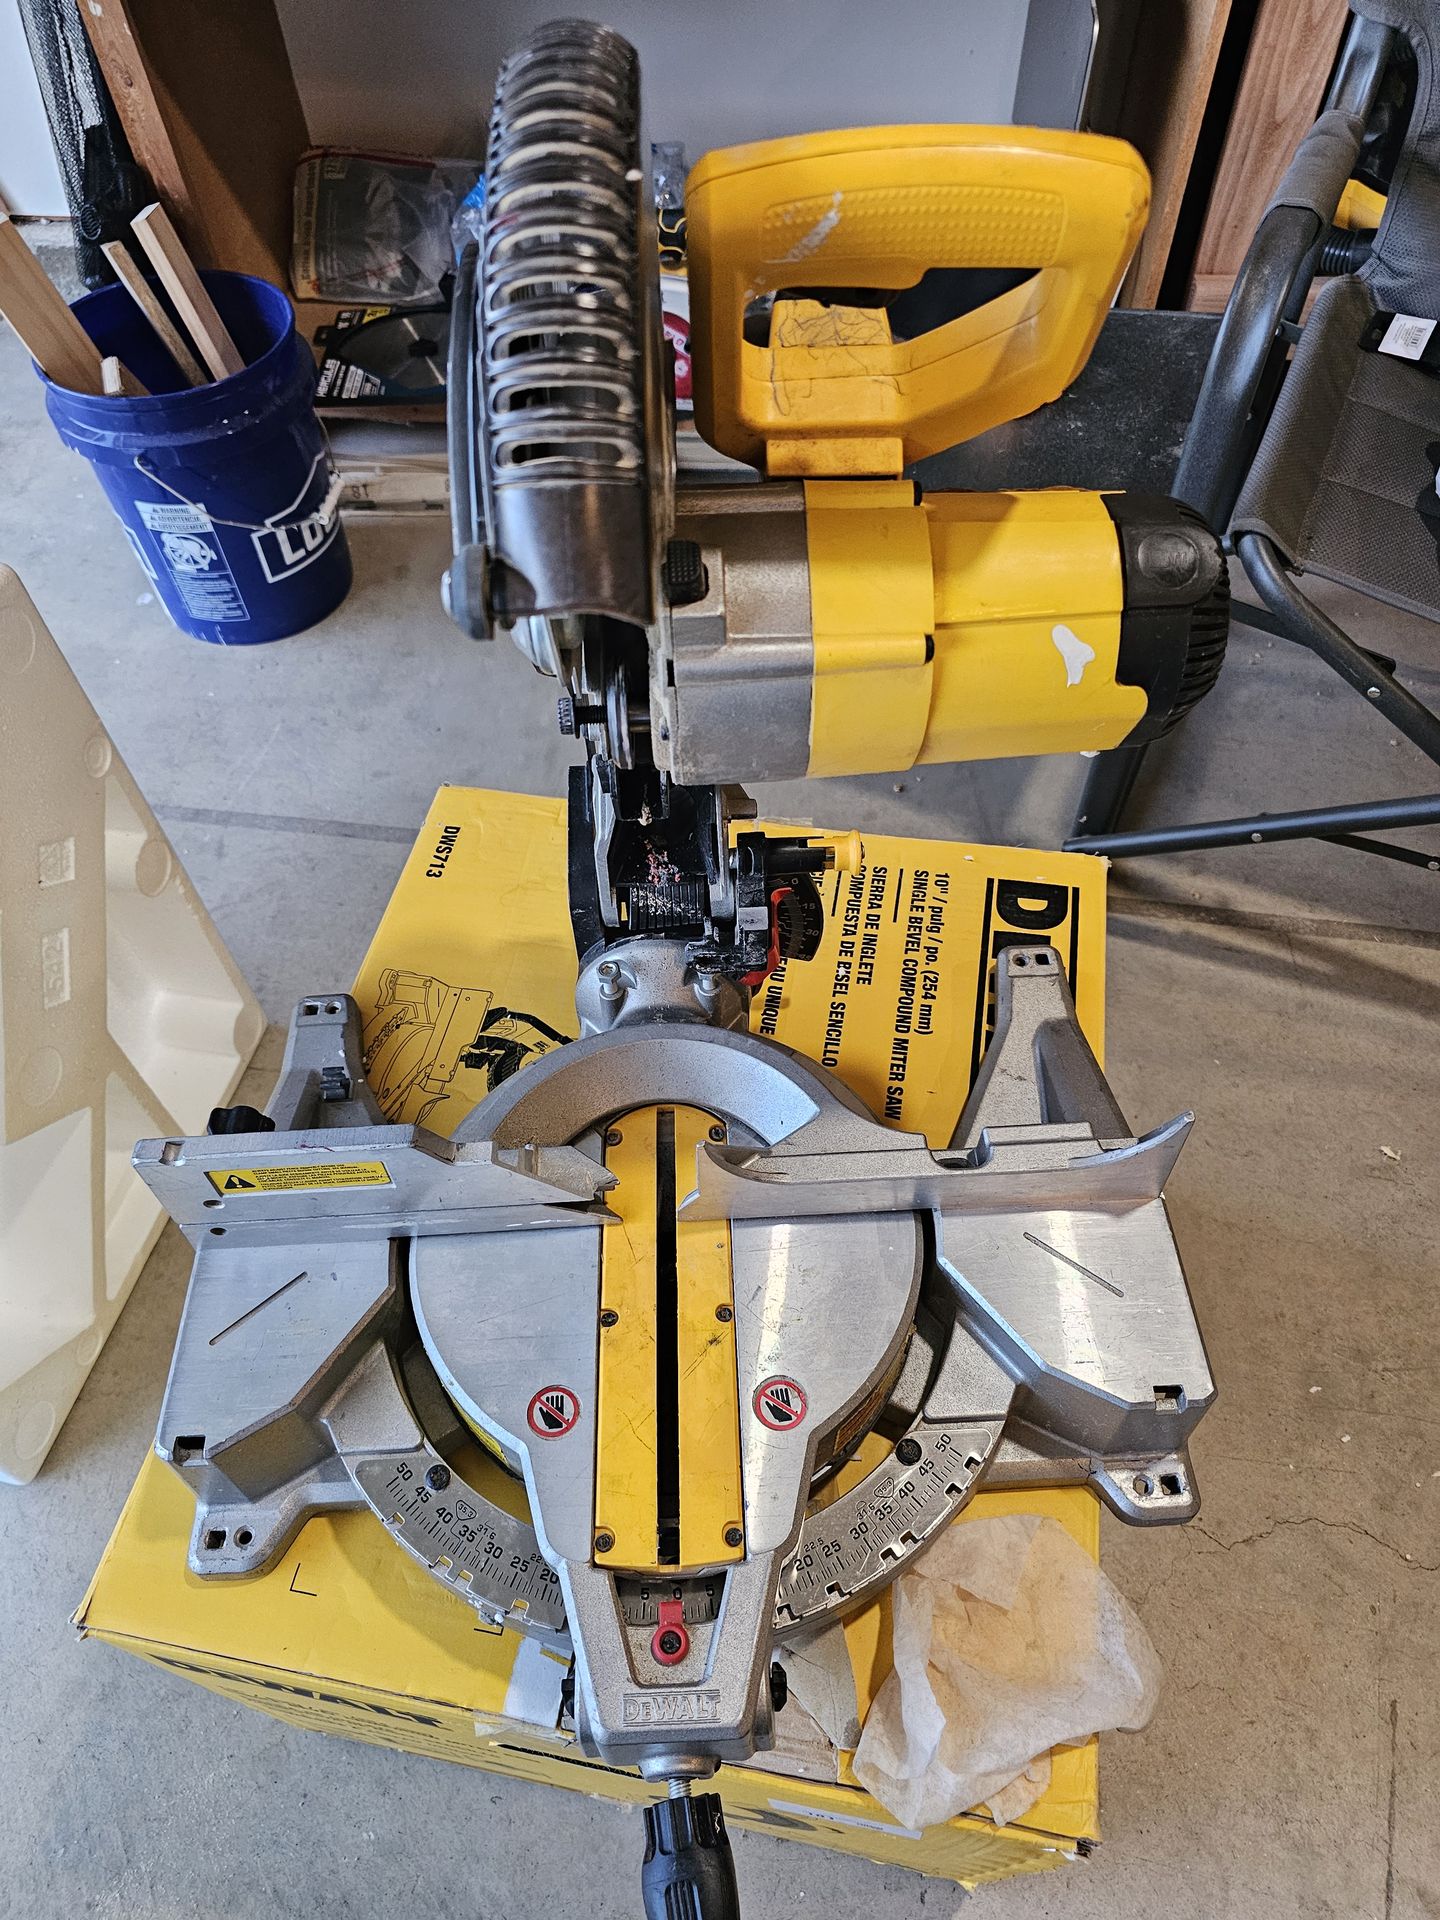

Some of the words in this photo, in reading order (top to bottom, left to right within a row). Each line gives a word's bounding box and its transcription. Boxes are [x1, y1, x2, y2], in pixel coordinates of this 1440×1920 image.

[315, 359, 338, 398] HERCULES
[426, 826, 461, 878] DWS713
[867, 866, 888, 909] SIERRA
[910, 870, 929, 912] SINGLE
[934, 873, 950, 894] 10"
[864, 914, 881, 930] DE
[926, 905, 945, 934] pulg
[904, 916, 923, 955] BEVEL
[838, 941, 856, 958] DE
[923, 946, 939, 966] po.
[856, 934, 878, 985] INGLETE
[920, 970, 940, 1000] (254
[894, 959, 919, 1034] COMPOUND
[760, 985, 783, 1036] UNIQUE
[913, 1004, 934, 1035] mm)
[821, 1001, 846, 1067] SENCILLO
[889, 1037, 909, 1082] MITER
[884, 1086, 904, 1121] SAW
[935, 1434, 952, 1453] 50
[397, 1462, 413, 1481] 50
[918, 1458, 935, 1477] 45
[415, 1486, 432, 1503] 45
[898, 1481, 916, 1500] 40
[436, 1507, 453, 1524] 40
[458, 1503, 474, 1518] 35.3
[874, 1502, 893, 1520] 35
[458, 1525, 478, 1543] 35
[476, 1524, 496, 1540] 31.6
[850, 1521, 869, 1540] 30
[484, 1541, 503, 1559] 30
[803, 1537, 824, 1552] 22.5
[822, 1540, 842, 1558] 25
[510, 1556, 529, 1573] 25
[530, 1553, 548, 1567] 22.
[794, 1554, 814, 1572] 20
[540, 1568, 559, 1584] 20
[640, 1587, 650, 1600] 5
[672, 1586, 683, 1600] 0
[704, 1584, 715, 1597] 5
[625, 1695, 721, 1722] DEWALT
